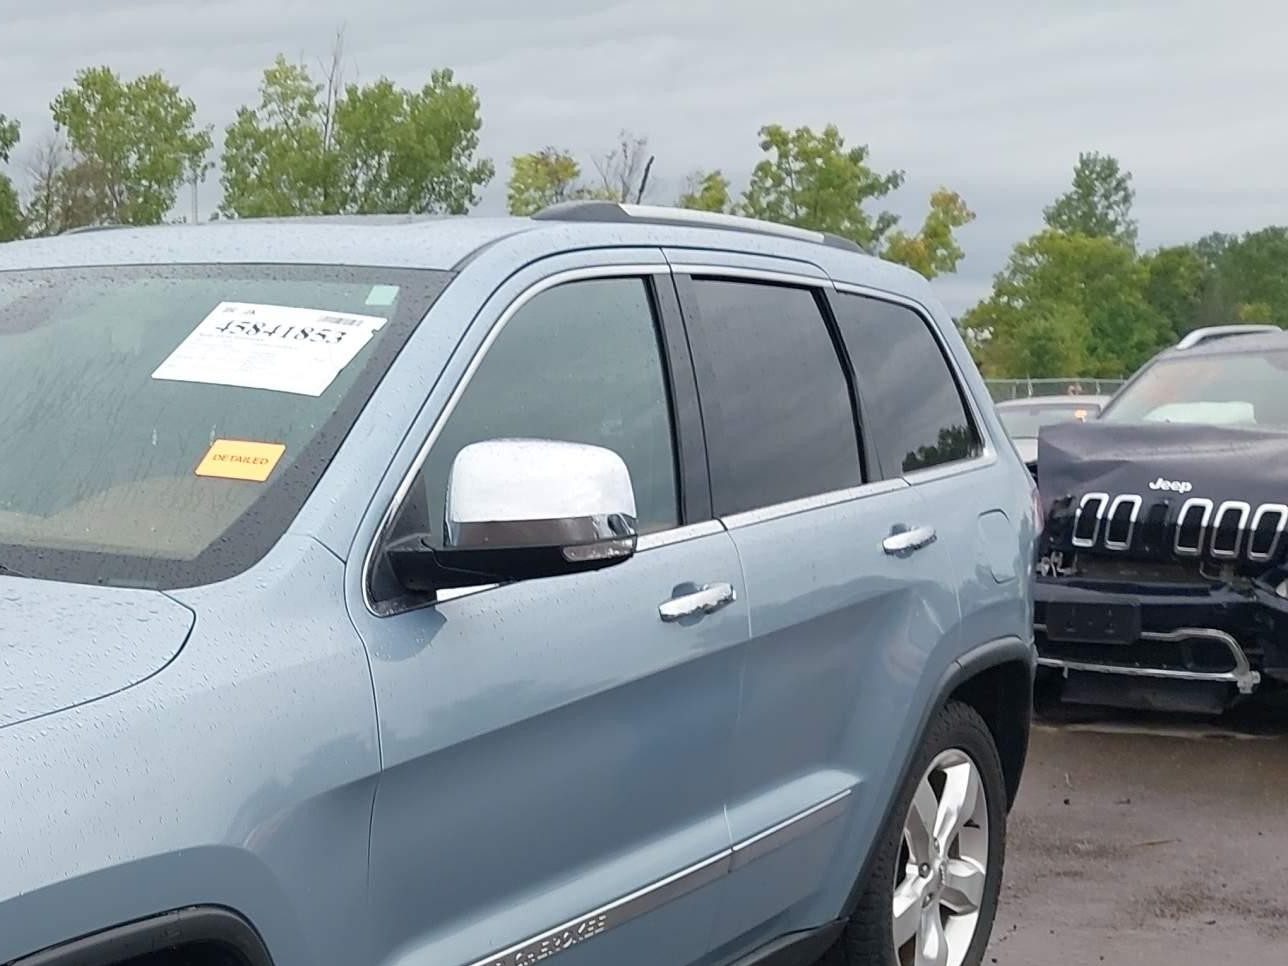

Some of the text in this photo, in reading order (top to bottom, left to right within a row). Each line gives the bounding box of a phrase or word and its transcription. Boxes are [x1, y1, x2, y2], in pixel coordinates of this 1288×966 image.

[215, 319, 347, 345] 45841853
[212, 453, 270, 465] DETAILED
[1149, 478, 1192, 494] Jeep
